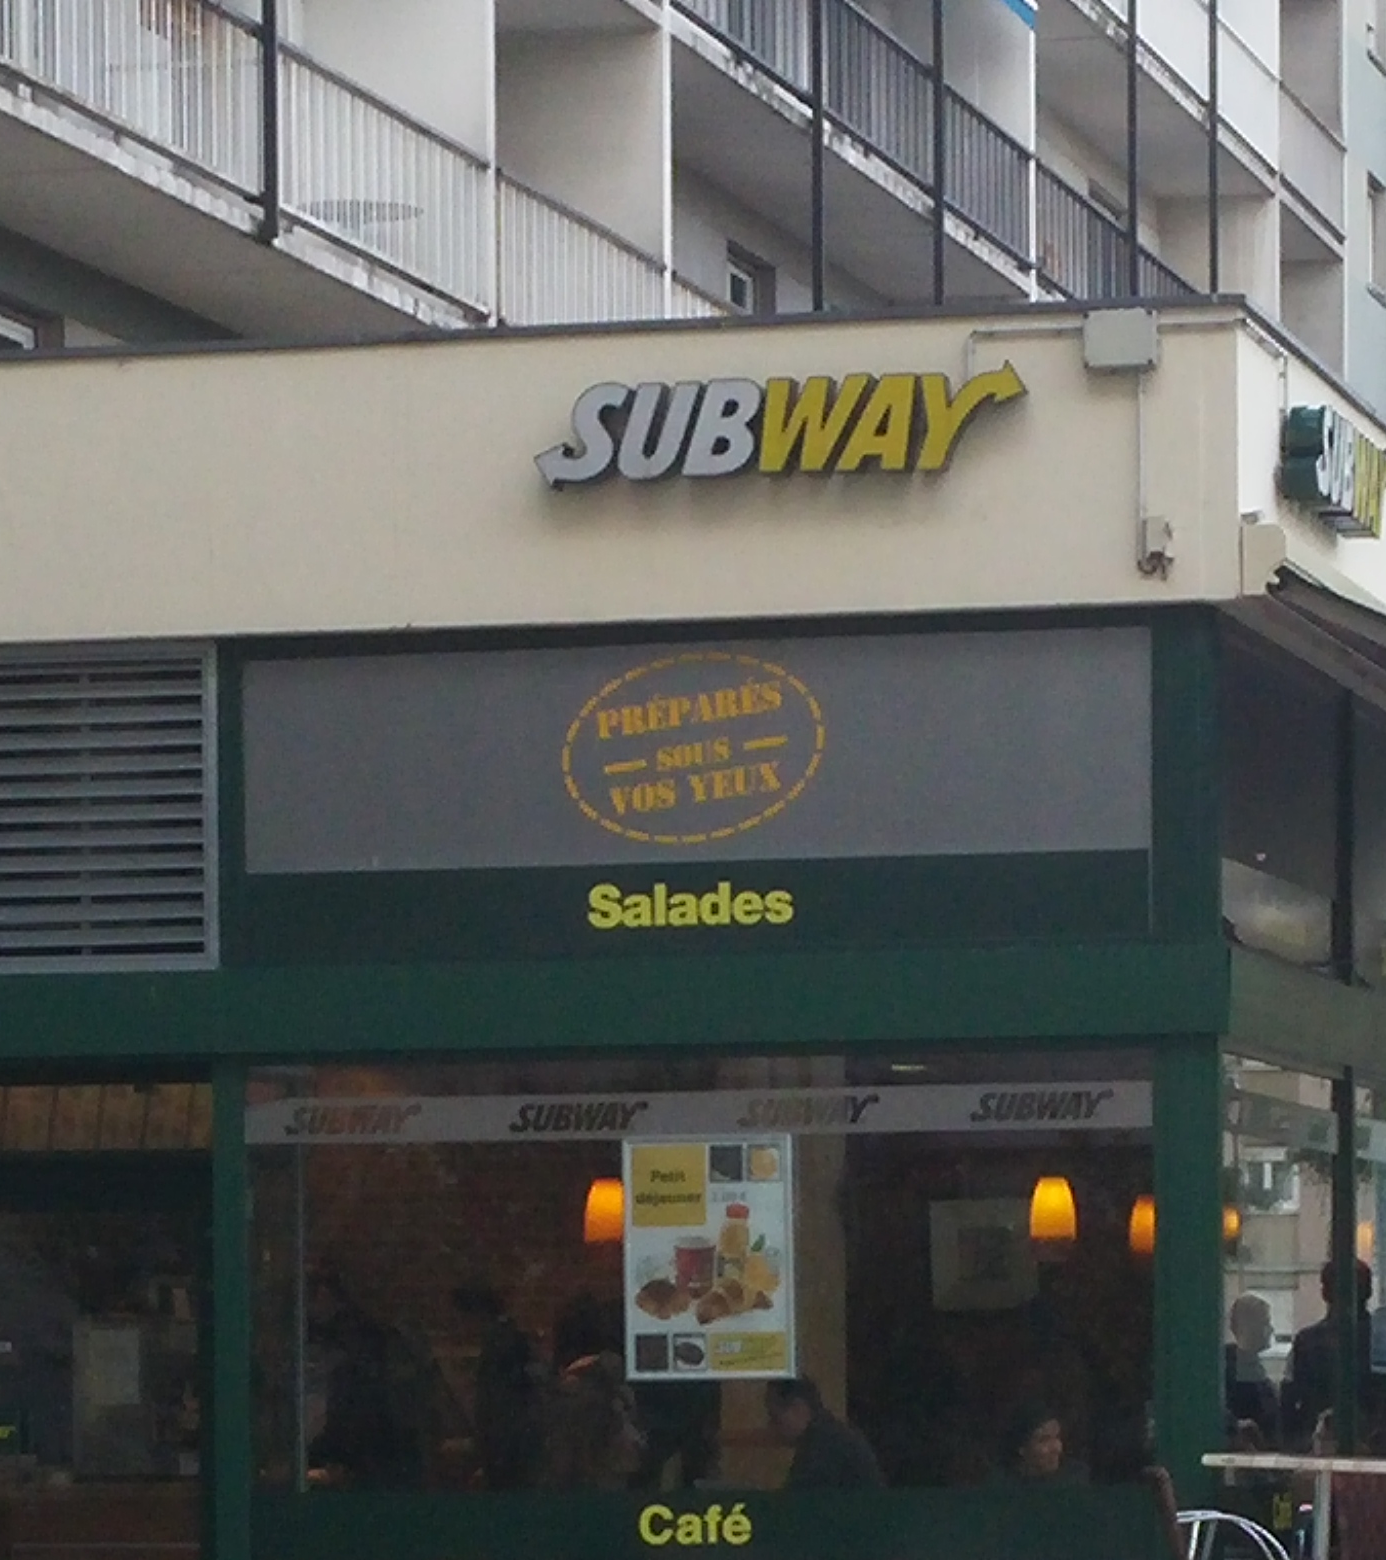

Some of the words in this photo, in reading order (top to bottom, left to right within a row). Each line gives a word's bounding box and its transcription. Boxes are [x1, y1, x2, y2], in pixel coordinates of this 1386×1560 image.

[534, 361, 1028, 489] SUBWAY
[596, 677, 783, 740] PRÉPARÉS
[655, 737, 732, 771] SOUS
[609, 779, 677, 816] VOS
[688, 761, 781, 803] YEUX
[587, 880, 795, 929] Salades
[283, 1102, 422, 1136] SUBWAY
[508, 1100, 649, 1133] SUBWAY
[736, 1093, 880, 1128] SUBWAY
[969, 1089, 1115, 1123] SUBWAY
[636, 1501, 754, 1548] Café
